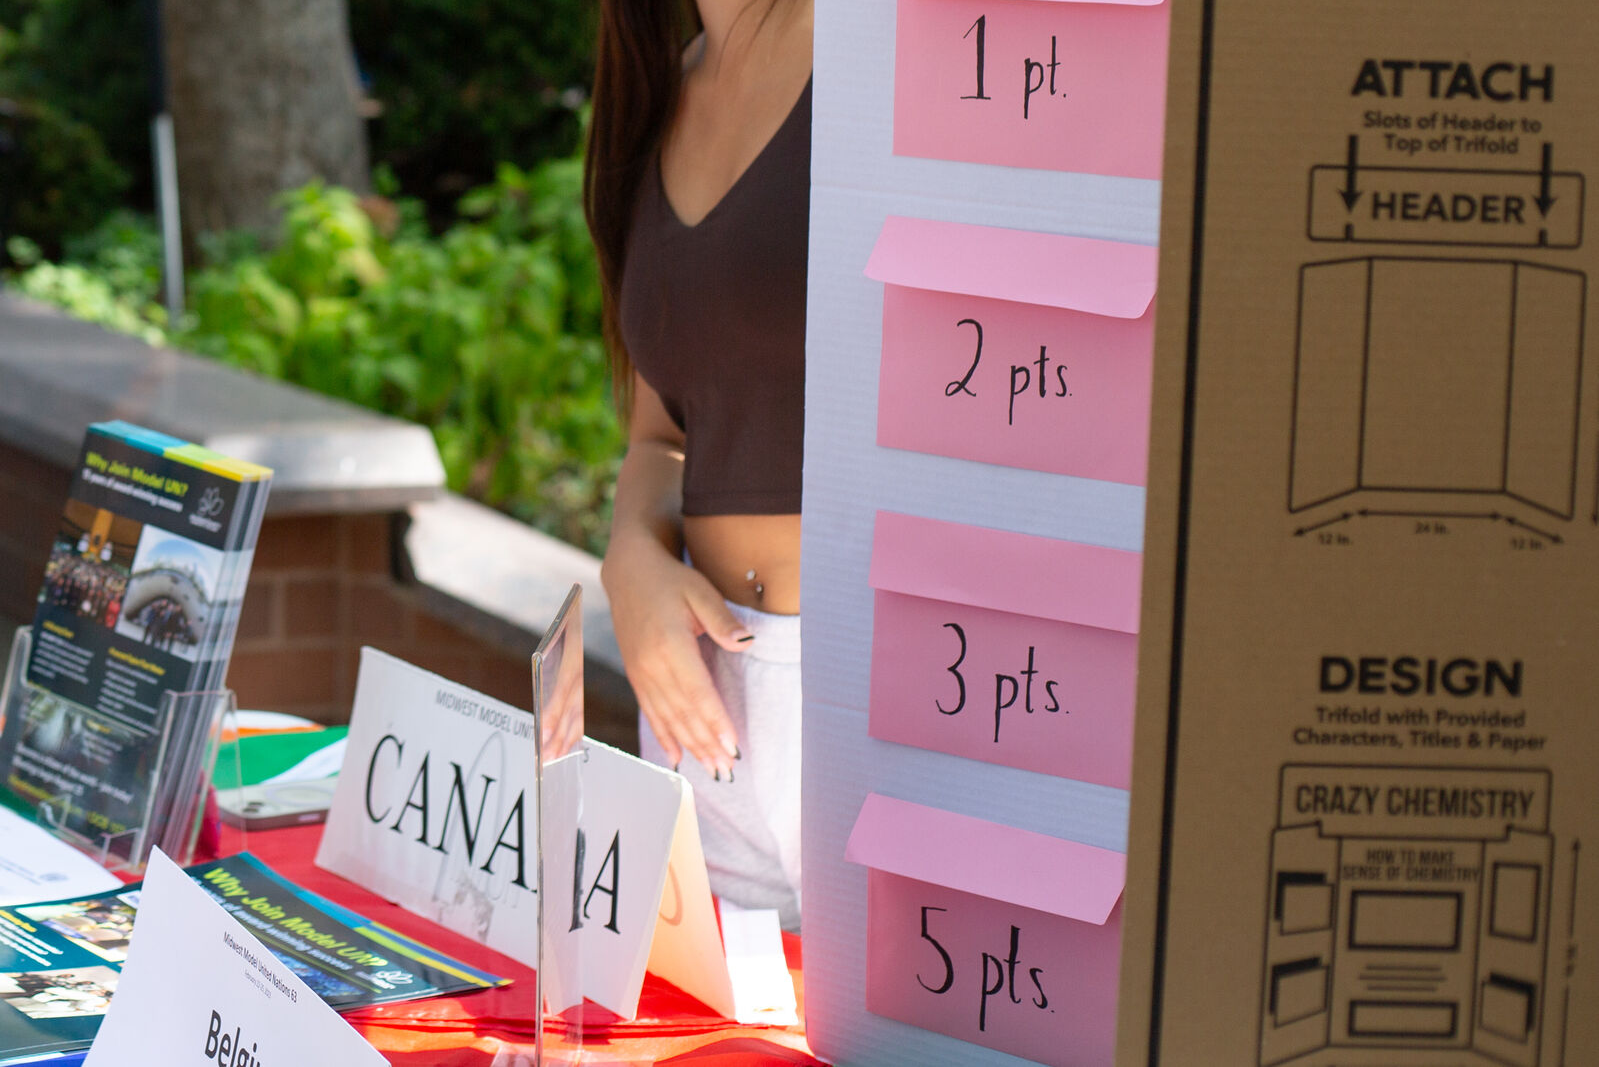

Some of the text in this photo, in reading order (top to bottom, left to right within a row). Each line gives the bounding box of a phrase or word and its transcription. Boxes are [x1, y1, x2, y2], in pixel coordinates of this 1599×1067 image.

[959, 14, 1068, 120] 1 pt.
[1351, 59, 1555, 103] ATTACH
[1363, 110, 1542, 133] Slots of Header to
[1384, 134, 1519, 155] Top of Trifold
[1371, 192, 1526, 224] HEADER
[944, 318, 1073, 426] 2 pts.
[935, 622, 1071, 744] 3 pts.
[1318, 655, 1524, 698] DESIGN
[436, 689, 479, 718] MIDWEST
[479, 706, 512, 733] MODEL
[1316, 706, 1526, 728] Trifold with Provided
[1293, 727, 1547, 754] Characters, Titles & Paper
[1295, 784, 1535, 819] CRAZY CHEMISTRY
[1366, 848, 1455, 866] HOW TO MAKE
[204, 867, 249, 897] Why
[241, 896, 286, 921] Join
[279, 916, 339, 949] Model
[336, 941, 389, 967] UN?
[223, 930, 243, 957] Midwest
[243, 947, 259, 970] Model
[258, 959, 273, 982] United
[272, 973, 291, 998] Nations
[916, 906, 1055, 1031] 5 pts.
